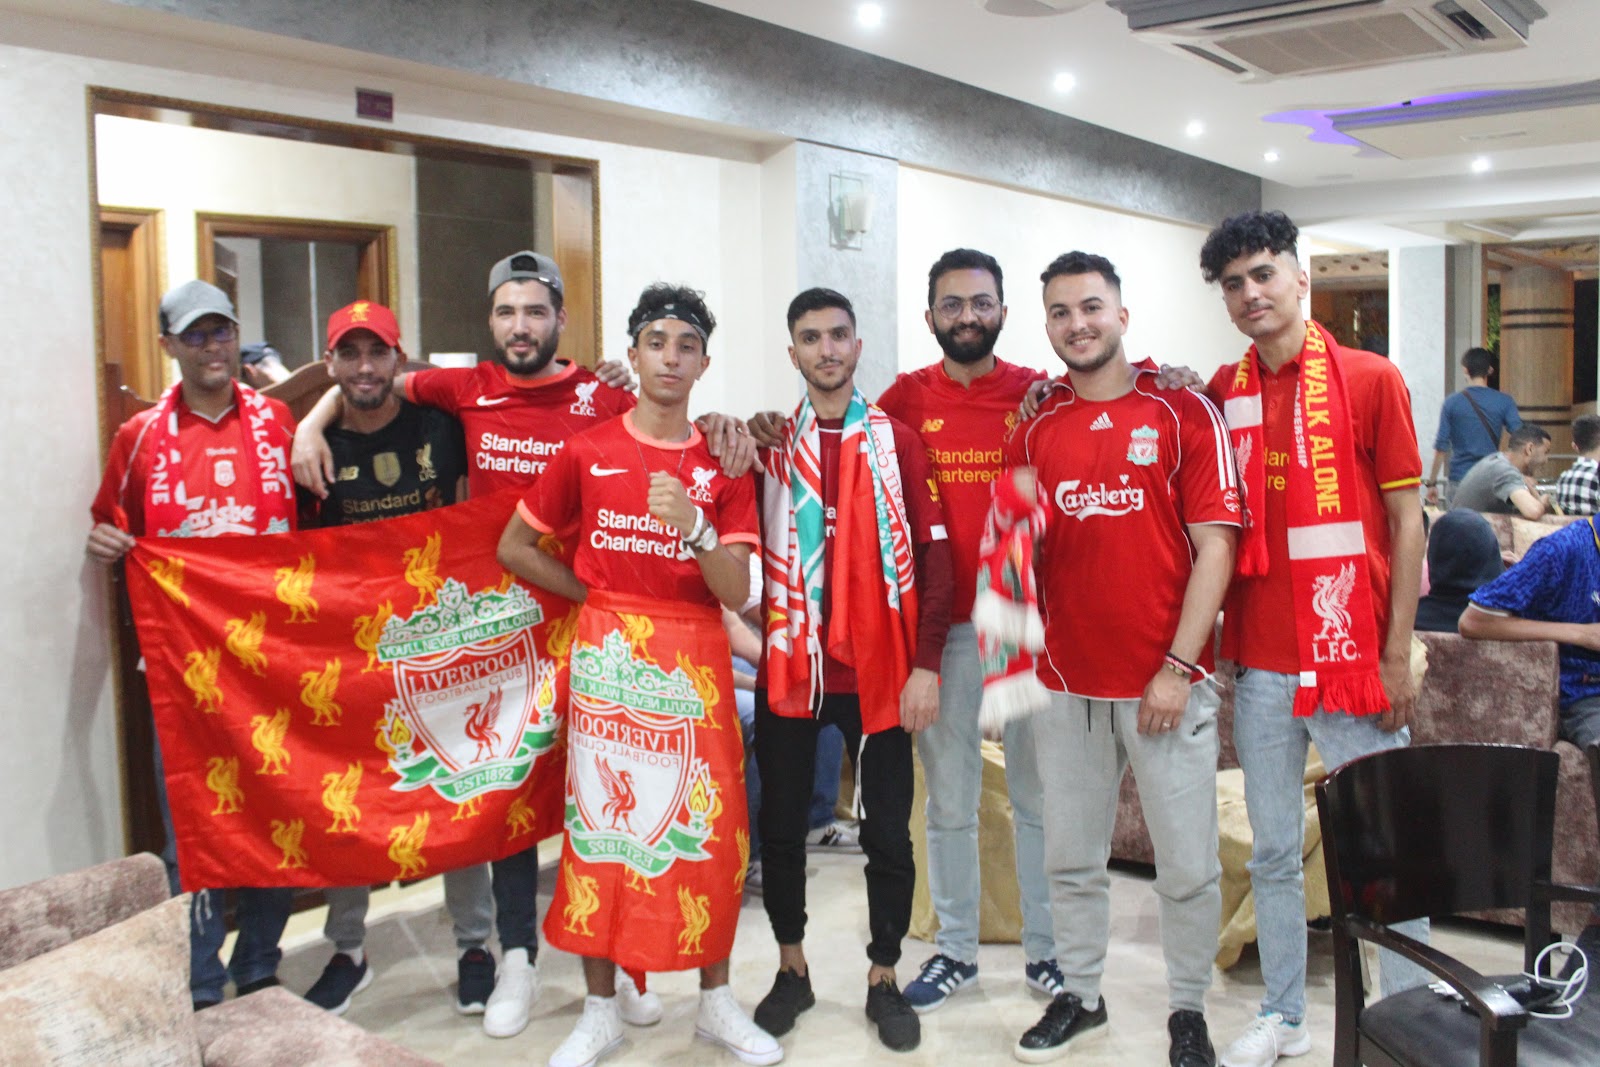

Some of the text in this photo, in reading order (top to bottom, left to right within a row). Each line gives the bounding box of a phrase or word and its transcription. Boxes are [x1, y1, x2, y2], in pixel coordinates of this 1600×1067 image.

[1304, 357, 1331, 429] WALK
[249, 414, 281, 495] ALONE
[476, 451, 548, 475] Chartere
[926, 447, 1003, 465] Standard
[932, 467, 1002, 483] hartered
[1309, 434, 1342, 516] ALONE
[342, 489, 421, 514] Standard
[1055, 479, 1145, 517] Carlsberg
[590, 529, 677, 559] Chartered
[422, 633, 461, 651] NEVER
[461, 625, 496, 643] WALK
[498, 610, 539, 632] ALONE
[408, 648, 528, 695] LIVERPOOL
[415, 667, 523, 706] FOOTBALL CLUB
